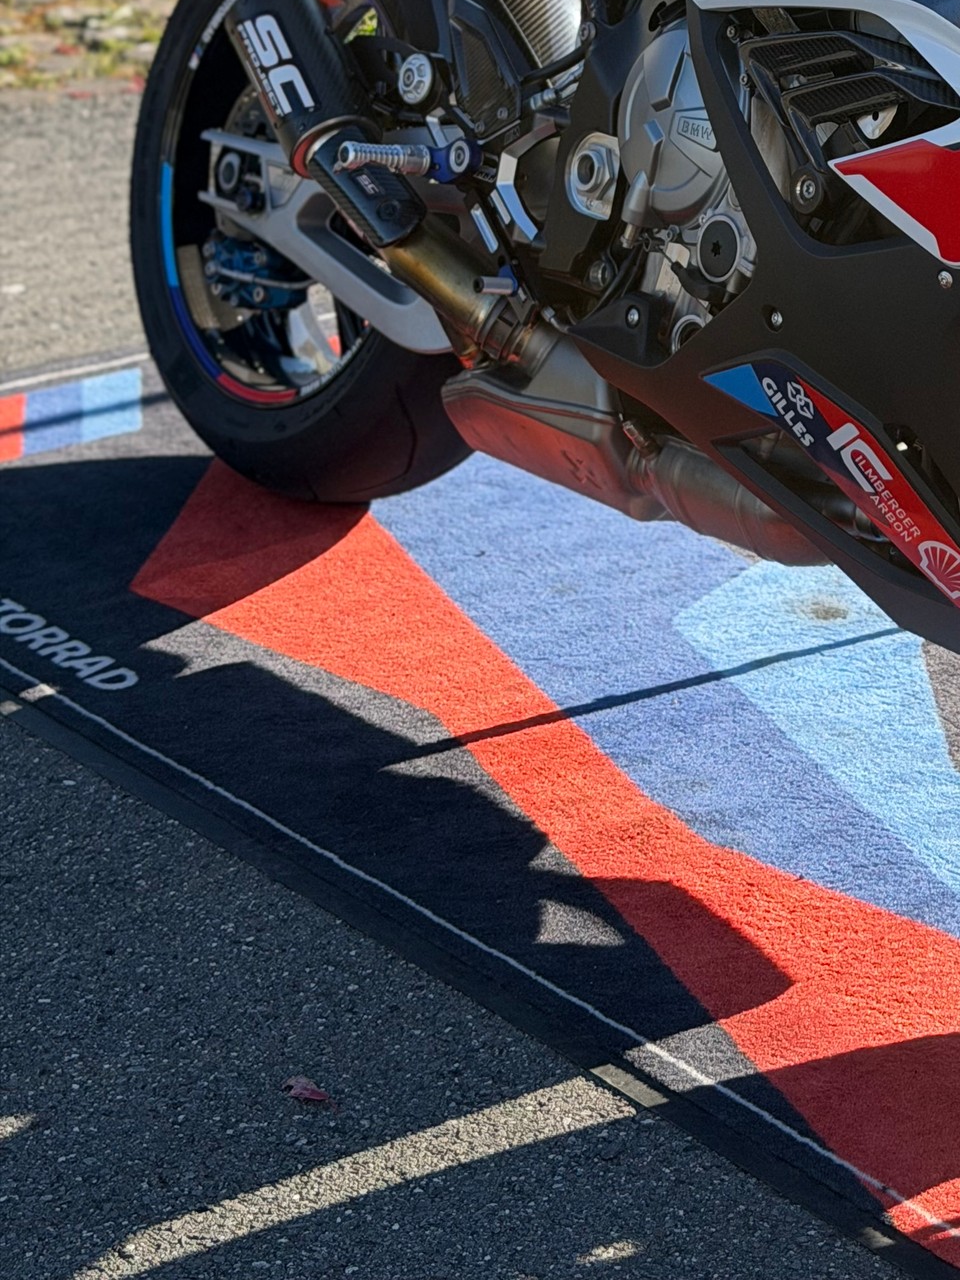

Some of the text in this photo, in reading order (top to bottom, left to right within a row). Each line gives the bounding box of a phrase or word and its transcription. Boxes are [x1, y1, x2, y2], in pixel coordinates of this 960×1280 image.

[243, 14, 315, 115] SC
[681, 119, 713, 140] BMW
[762, 377, 815, 447] GILLES
[854, 455, 921, 539] ILMBERGER
